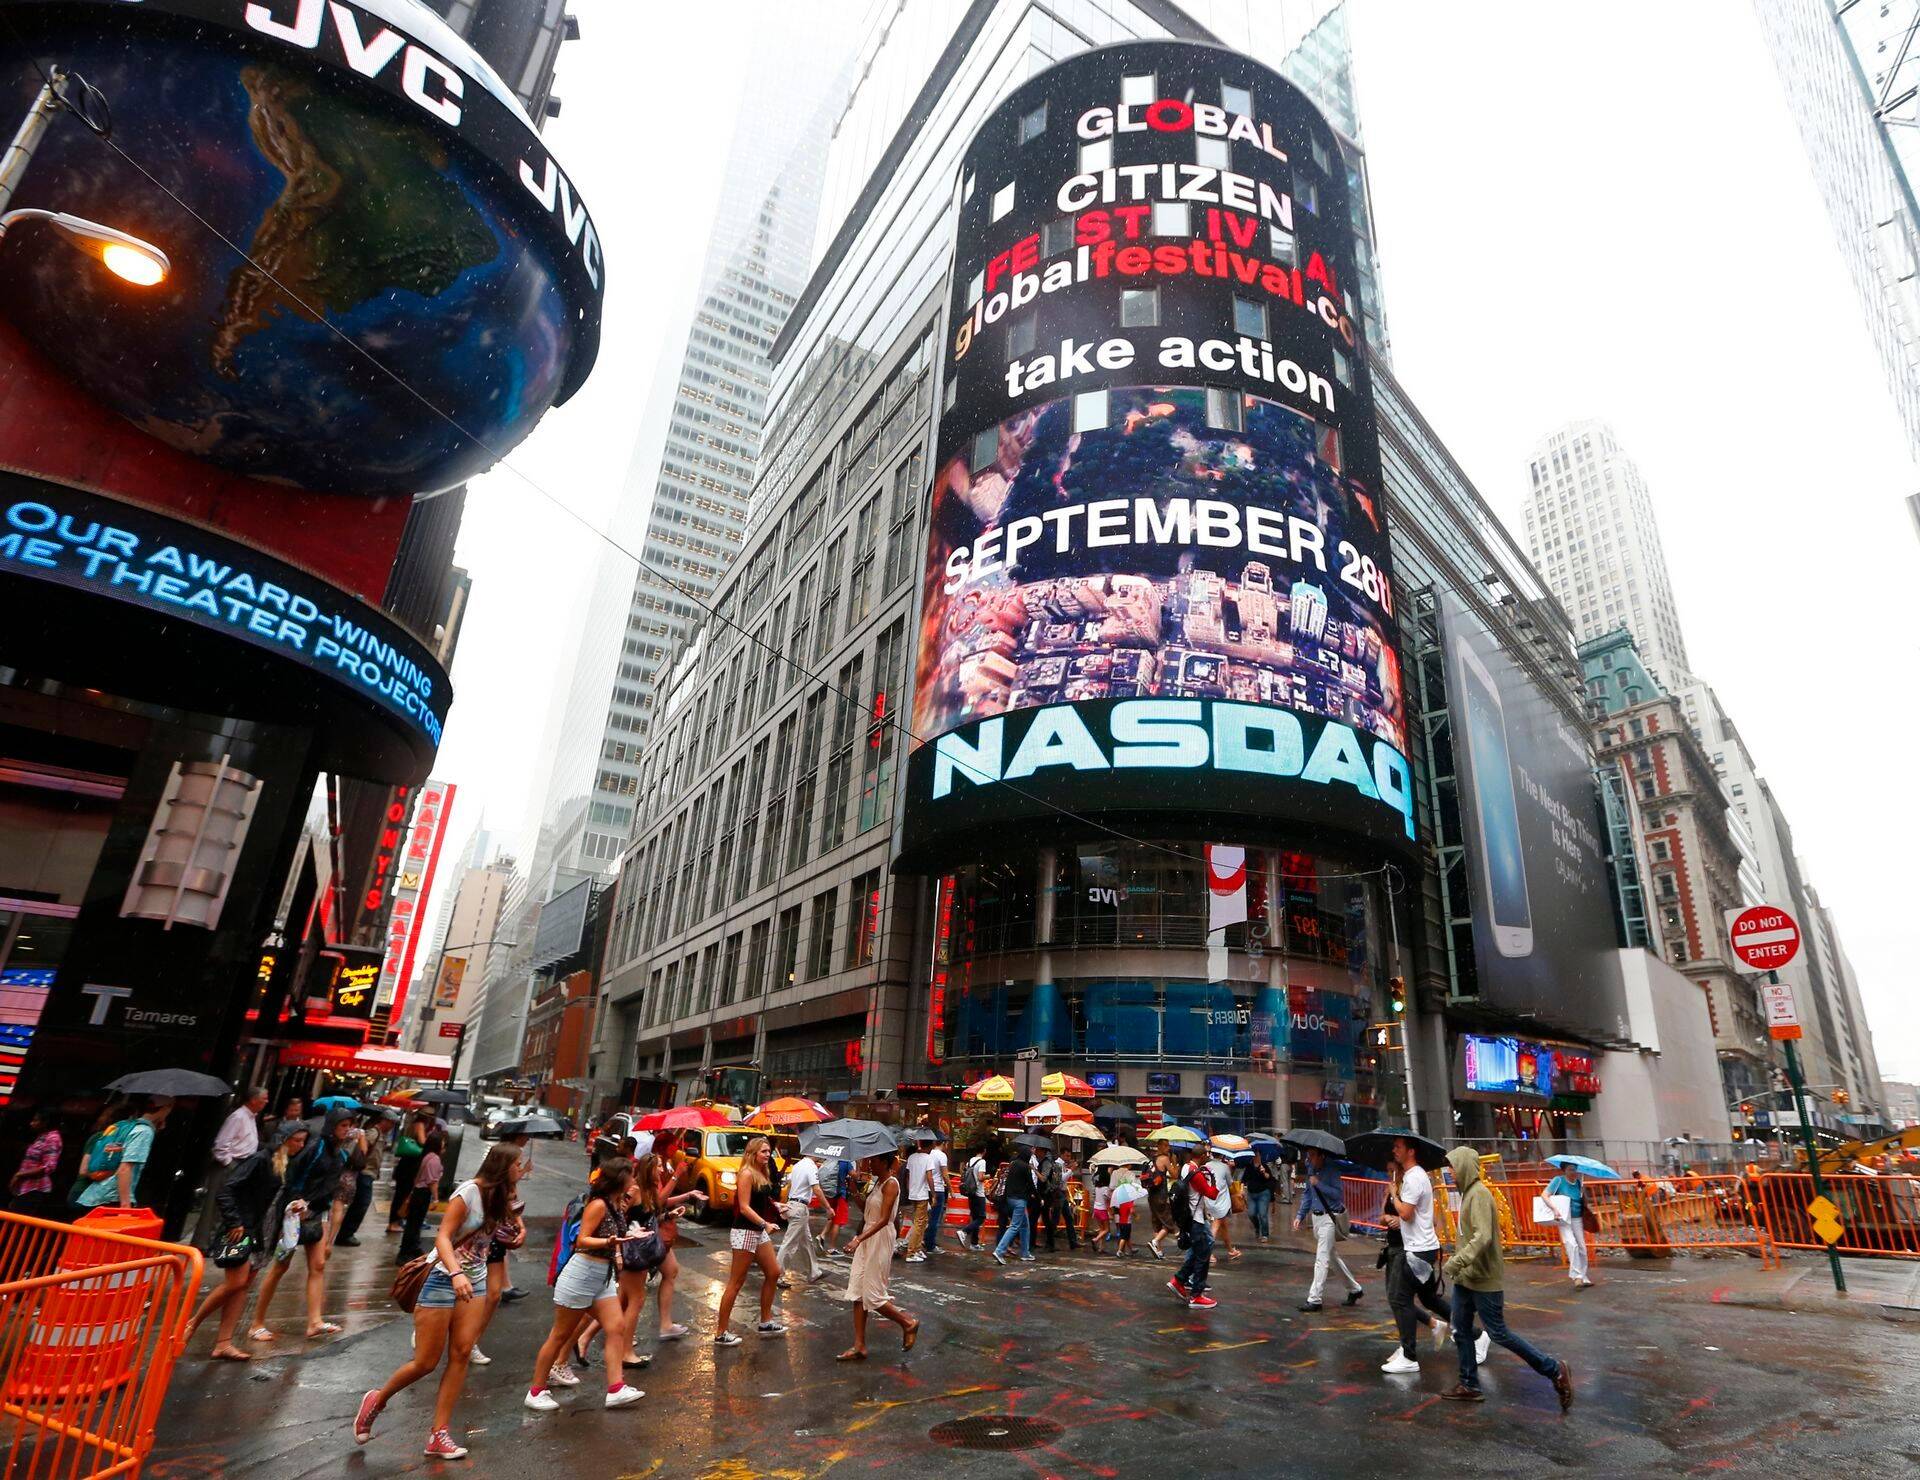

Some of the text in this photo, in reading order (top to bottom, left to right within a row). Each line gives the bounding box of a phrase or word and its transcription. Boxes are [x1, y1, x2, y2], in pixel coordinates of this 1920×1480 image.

[245, 0, 465, 126] JVC
[1076, 99, 1288, 161] GLOBAL
[519, 156, 601, 290] JVC
[1057, 163, 1293, 230] CITIZEN
[1005, 336, 1336, 412] take action
[943, 498, 1328, 596] SEPTEMBER
[6, 501, 432, 698] OUR AWARD-WINNING
[75, 546, 305, 650] THEATER
[932, 700, 1416, 841] NASDAQ
[1517, 764, 1538, 800] The
[1539, 784, 1562, 822] Next
[1561, 804, 1577, 839] Big
[1561, 829, 1583, 863] Here
[1740, 916, 1783, 931] DO NOT
[1748, 945, 1787, 959] ENTER
[81, 983, 133, 1025] T
[125, 1007, 197, 1026] Tamares
[1771, 988, 1782, 996] NO
[354, 1063, 398, 1074] AMERICAN
[814, 1147, 842, 1157] SPORTS
